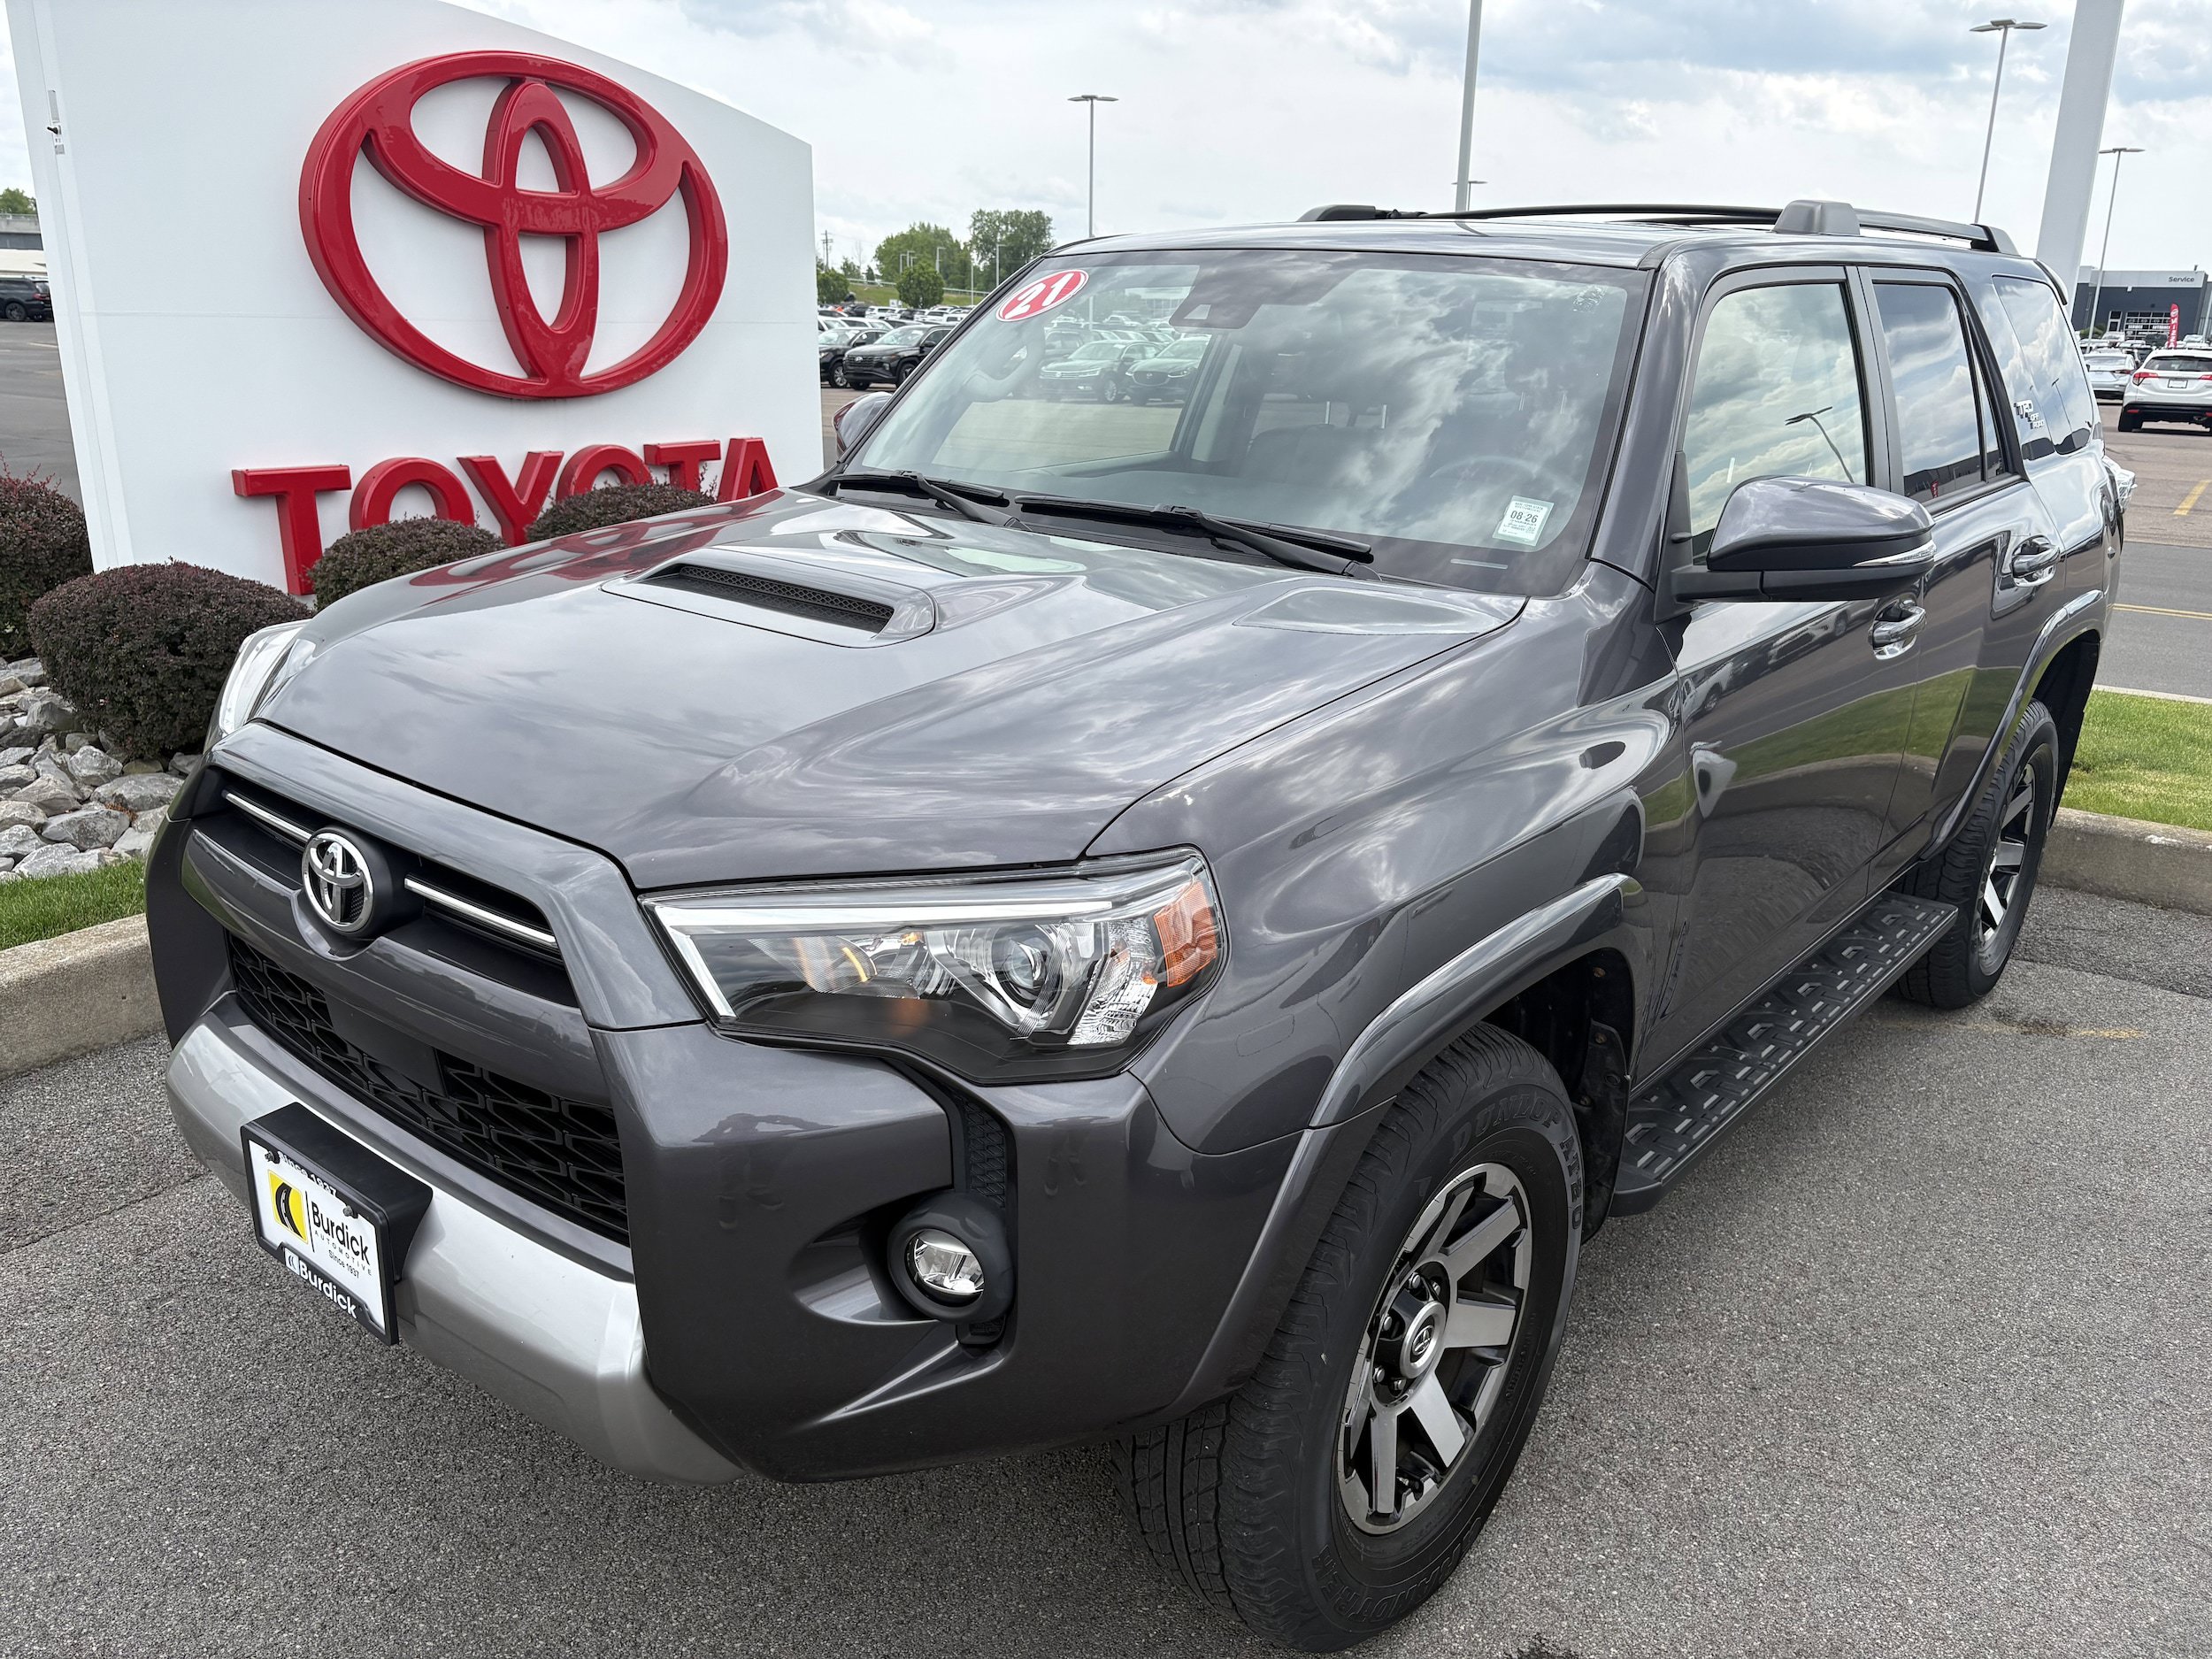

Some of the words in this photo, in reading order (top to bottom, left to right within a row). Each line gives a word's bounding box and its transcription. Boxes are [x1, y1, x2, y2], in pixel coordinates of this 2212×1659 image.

[1004, 273, 1075, 320] 21
[2016, 400, 2034, 415] TRD
[232, 436, 780, 595] TOYOTA
[1450, 1094, 1563, 1164] DUNLOP
[278, 1150, 306, 1174] Since
[310, 1173, 337, 1195] 1937
[311, 1201, 370, 1265] Burdick
[315, 1230, 372, 1276] AUTOMOTIVE
[328, 1249, 345, 1268] Since
[346, 1263, 359, 1279] 1937
[300, 1260, 357, 1318] Burdick
